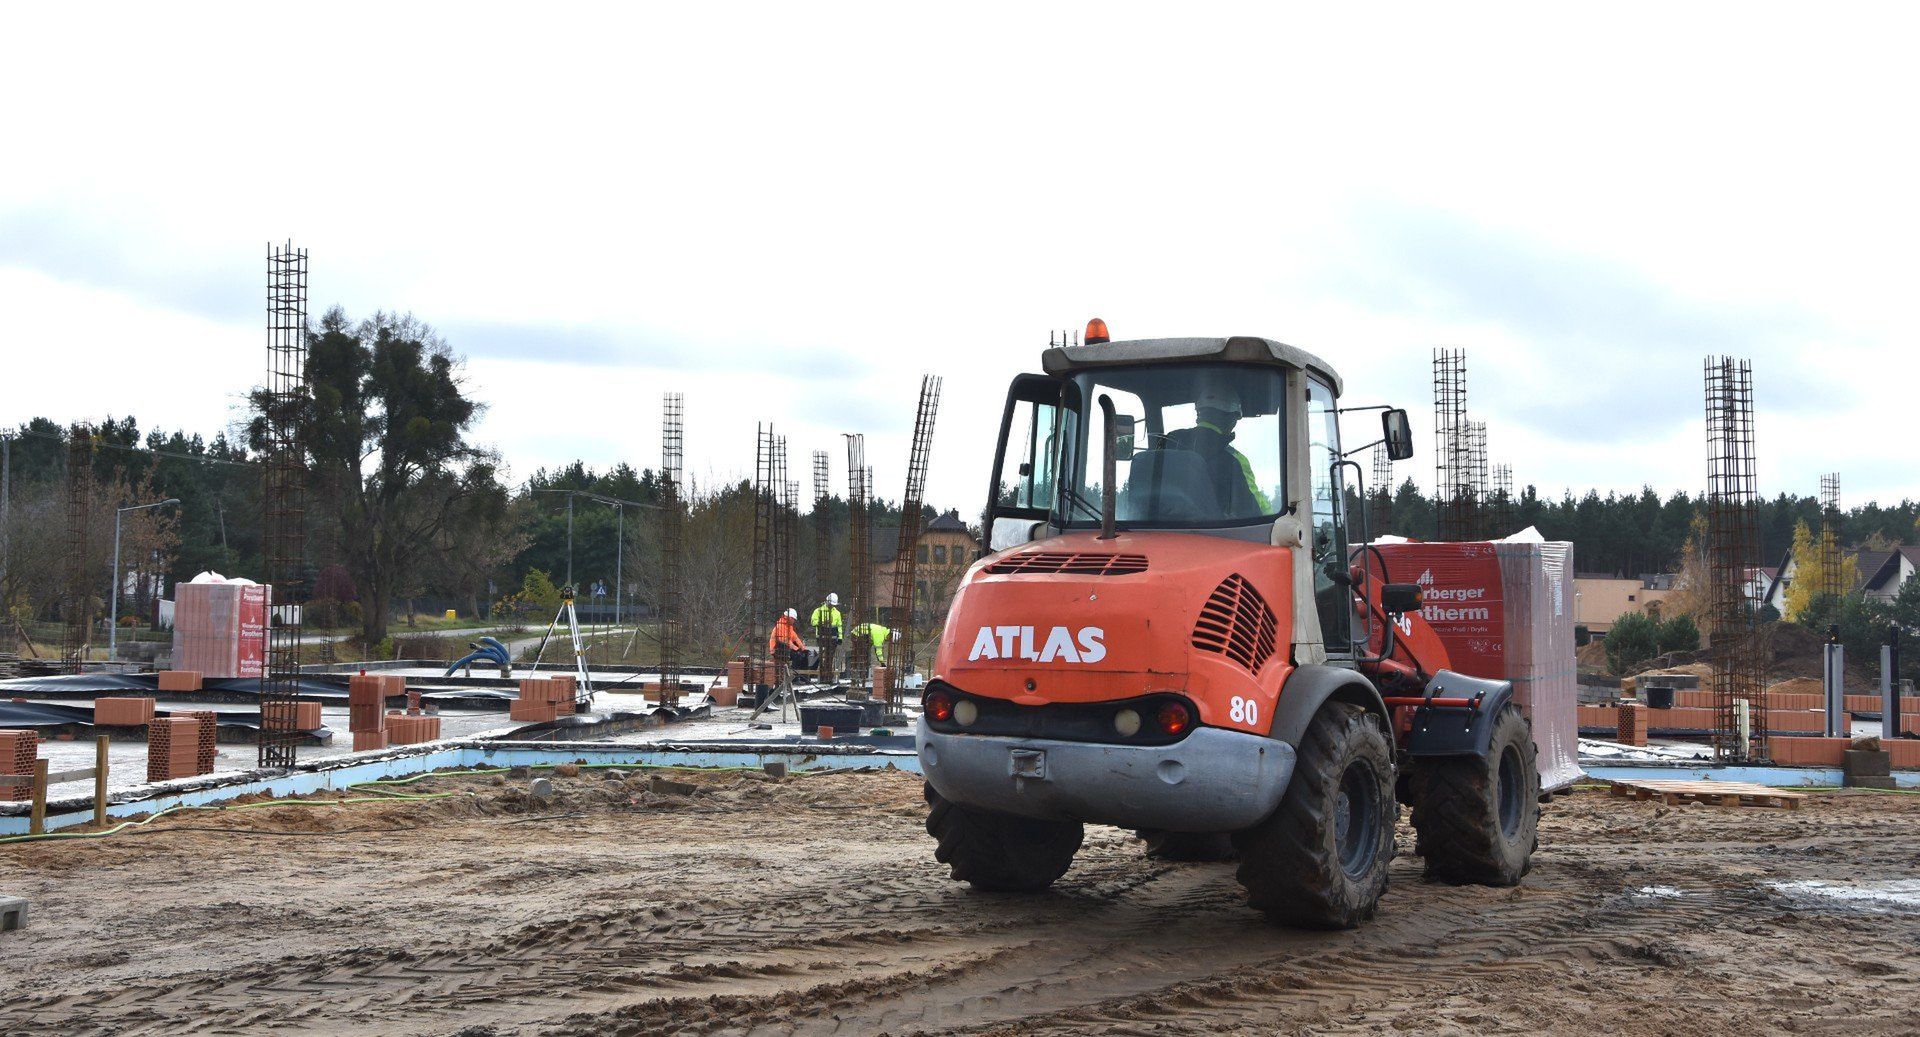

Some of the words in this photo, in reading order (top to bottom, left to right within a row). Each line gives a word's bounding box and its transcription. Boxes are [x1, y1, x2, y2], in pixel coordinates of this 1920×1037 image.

[1423, 587, 1485, 601] rberger
[1418, 605, 1489, 620] therm
[968, 625, 1107, 664] ATLAS
[1492, 643, 1502, 651] CE
[1229, 695, 1258, 726] 80
